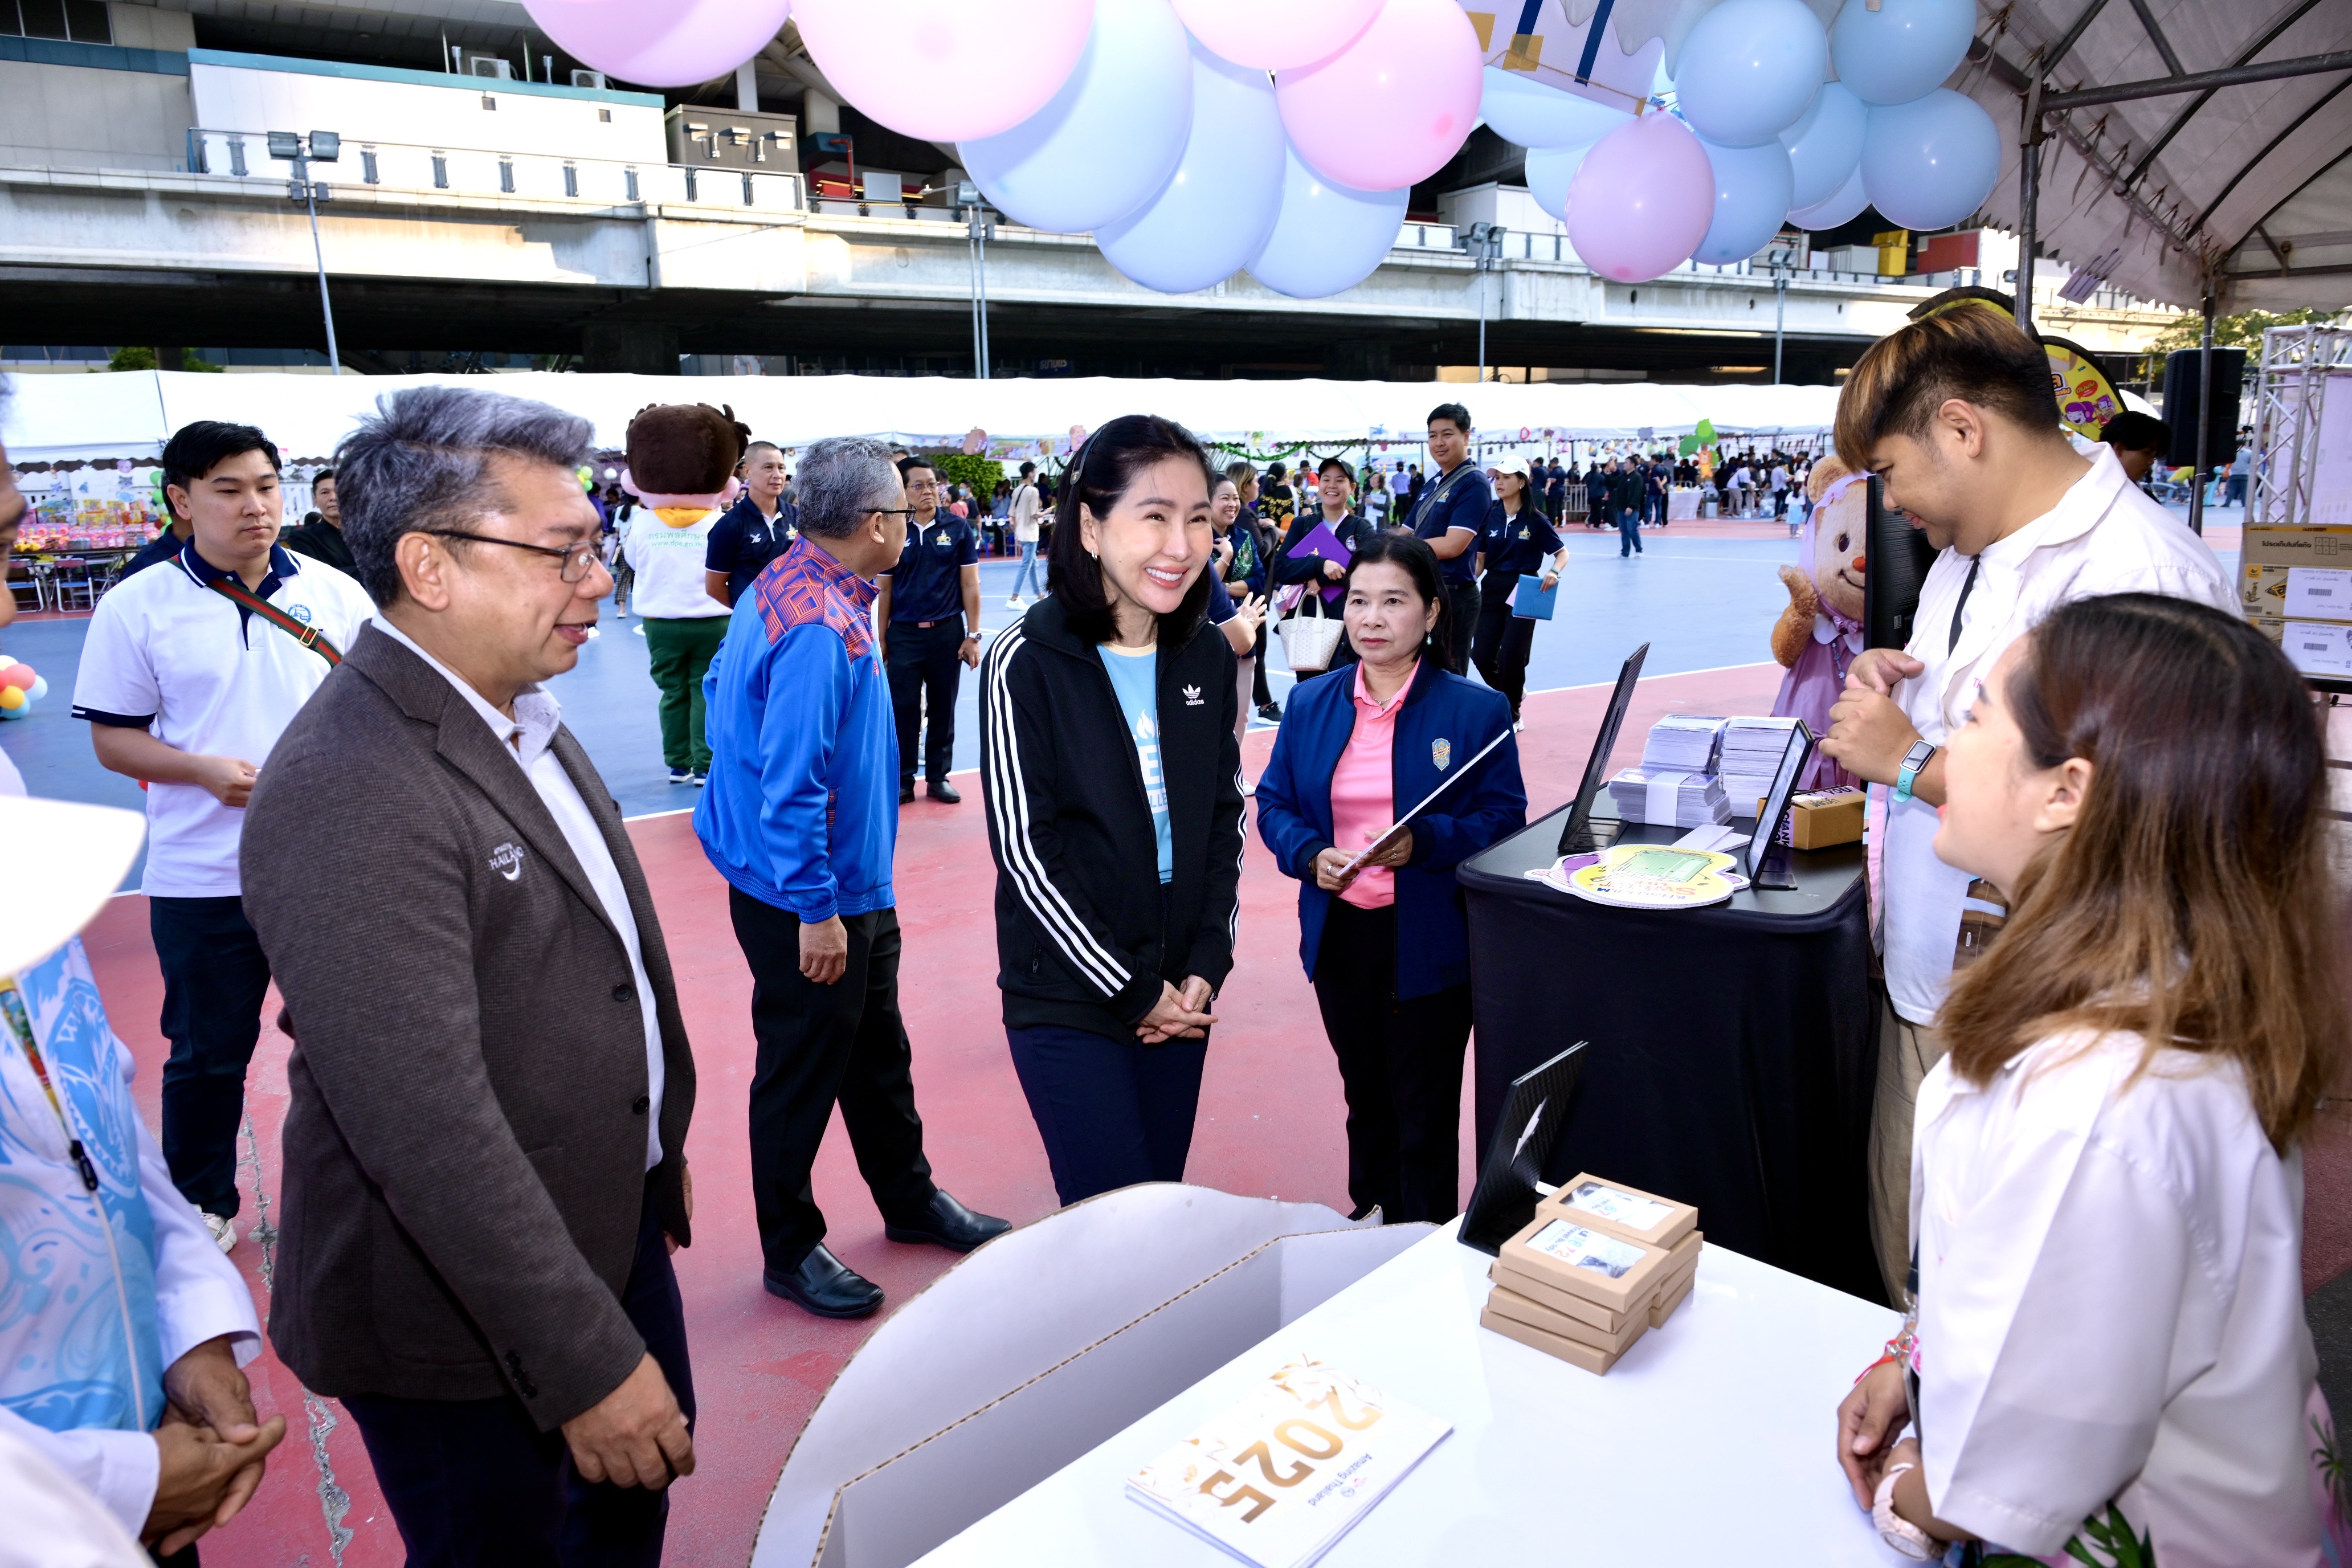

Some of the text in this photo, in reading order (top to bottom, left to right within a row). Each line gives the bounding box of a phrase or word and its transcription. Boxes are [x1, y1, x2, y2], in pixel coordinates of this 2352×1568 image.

[648, 529, 706, 540] กรมพลศึกษา
[1199, 1385, 1385, 1524] 2025
[1308, 1453, 1373, 1507] Amazing Thailand
